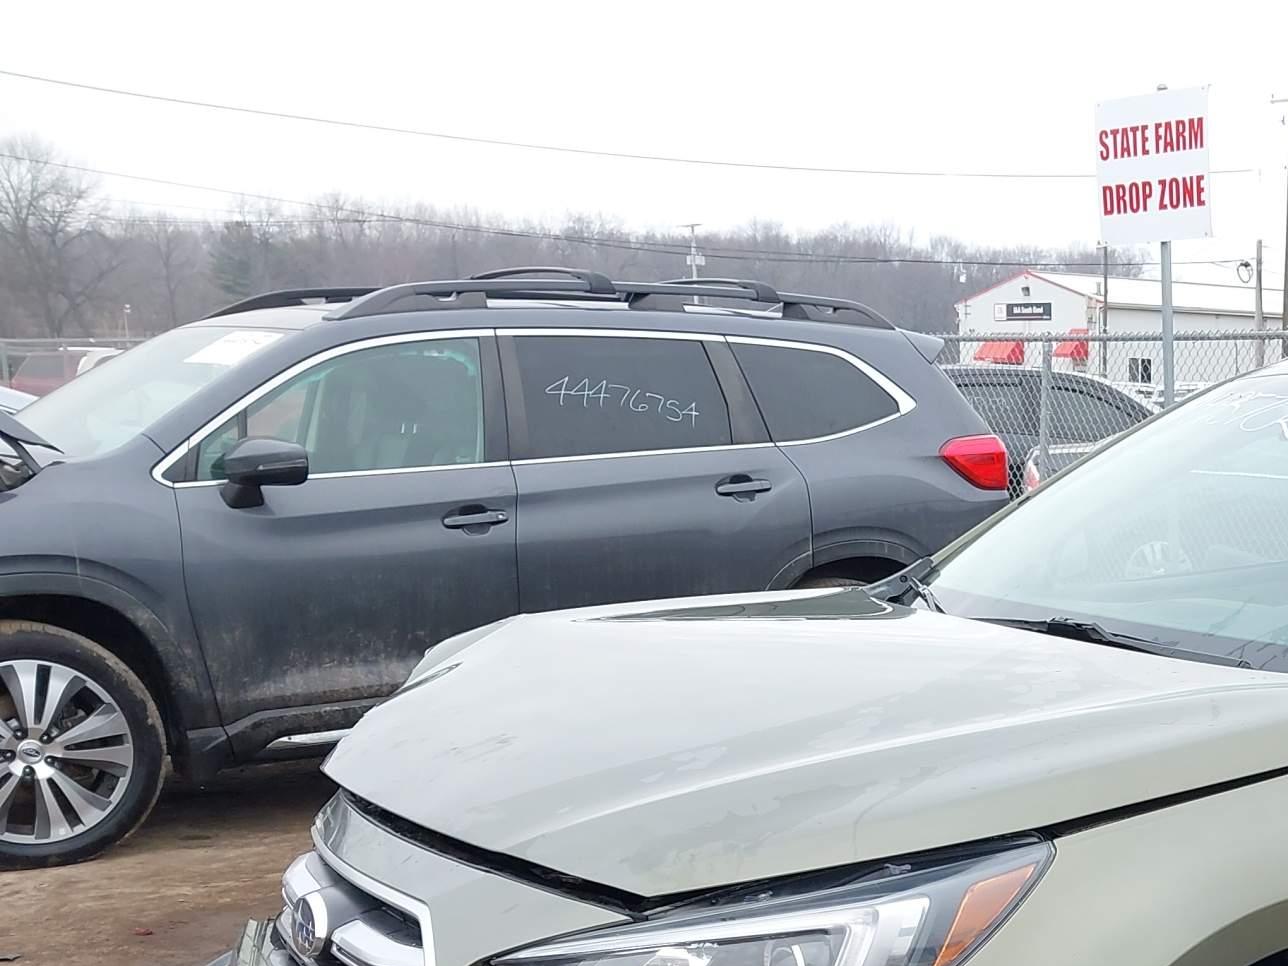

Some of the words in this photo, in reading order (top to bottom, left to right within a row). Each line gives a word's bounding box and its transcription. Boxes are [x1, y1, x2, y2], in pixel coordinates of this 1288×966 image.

[1100, 127, 1150, 161] STATE
[1154, 117, 1204, 154] FARM
[1102, 181, 1153, 216] DROP
[1157, 174, 1206, 210] ZONE
[545, 376, 700, 428] 44476754
